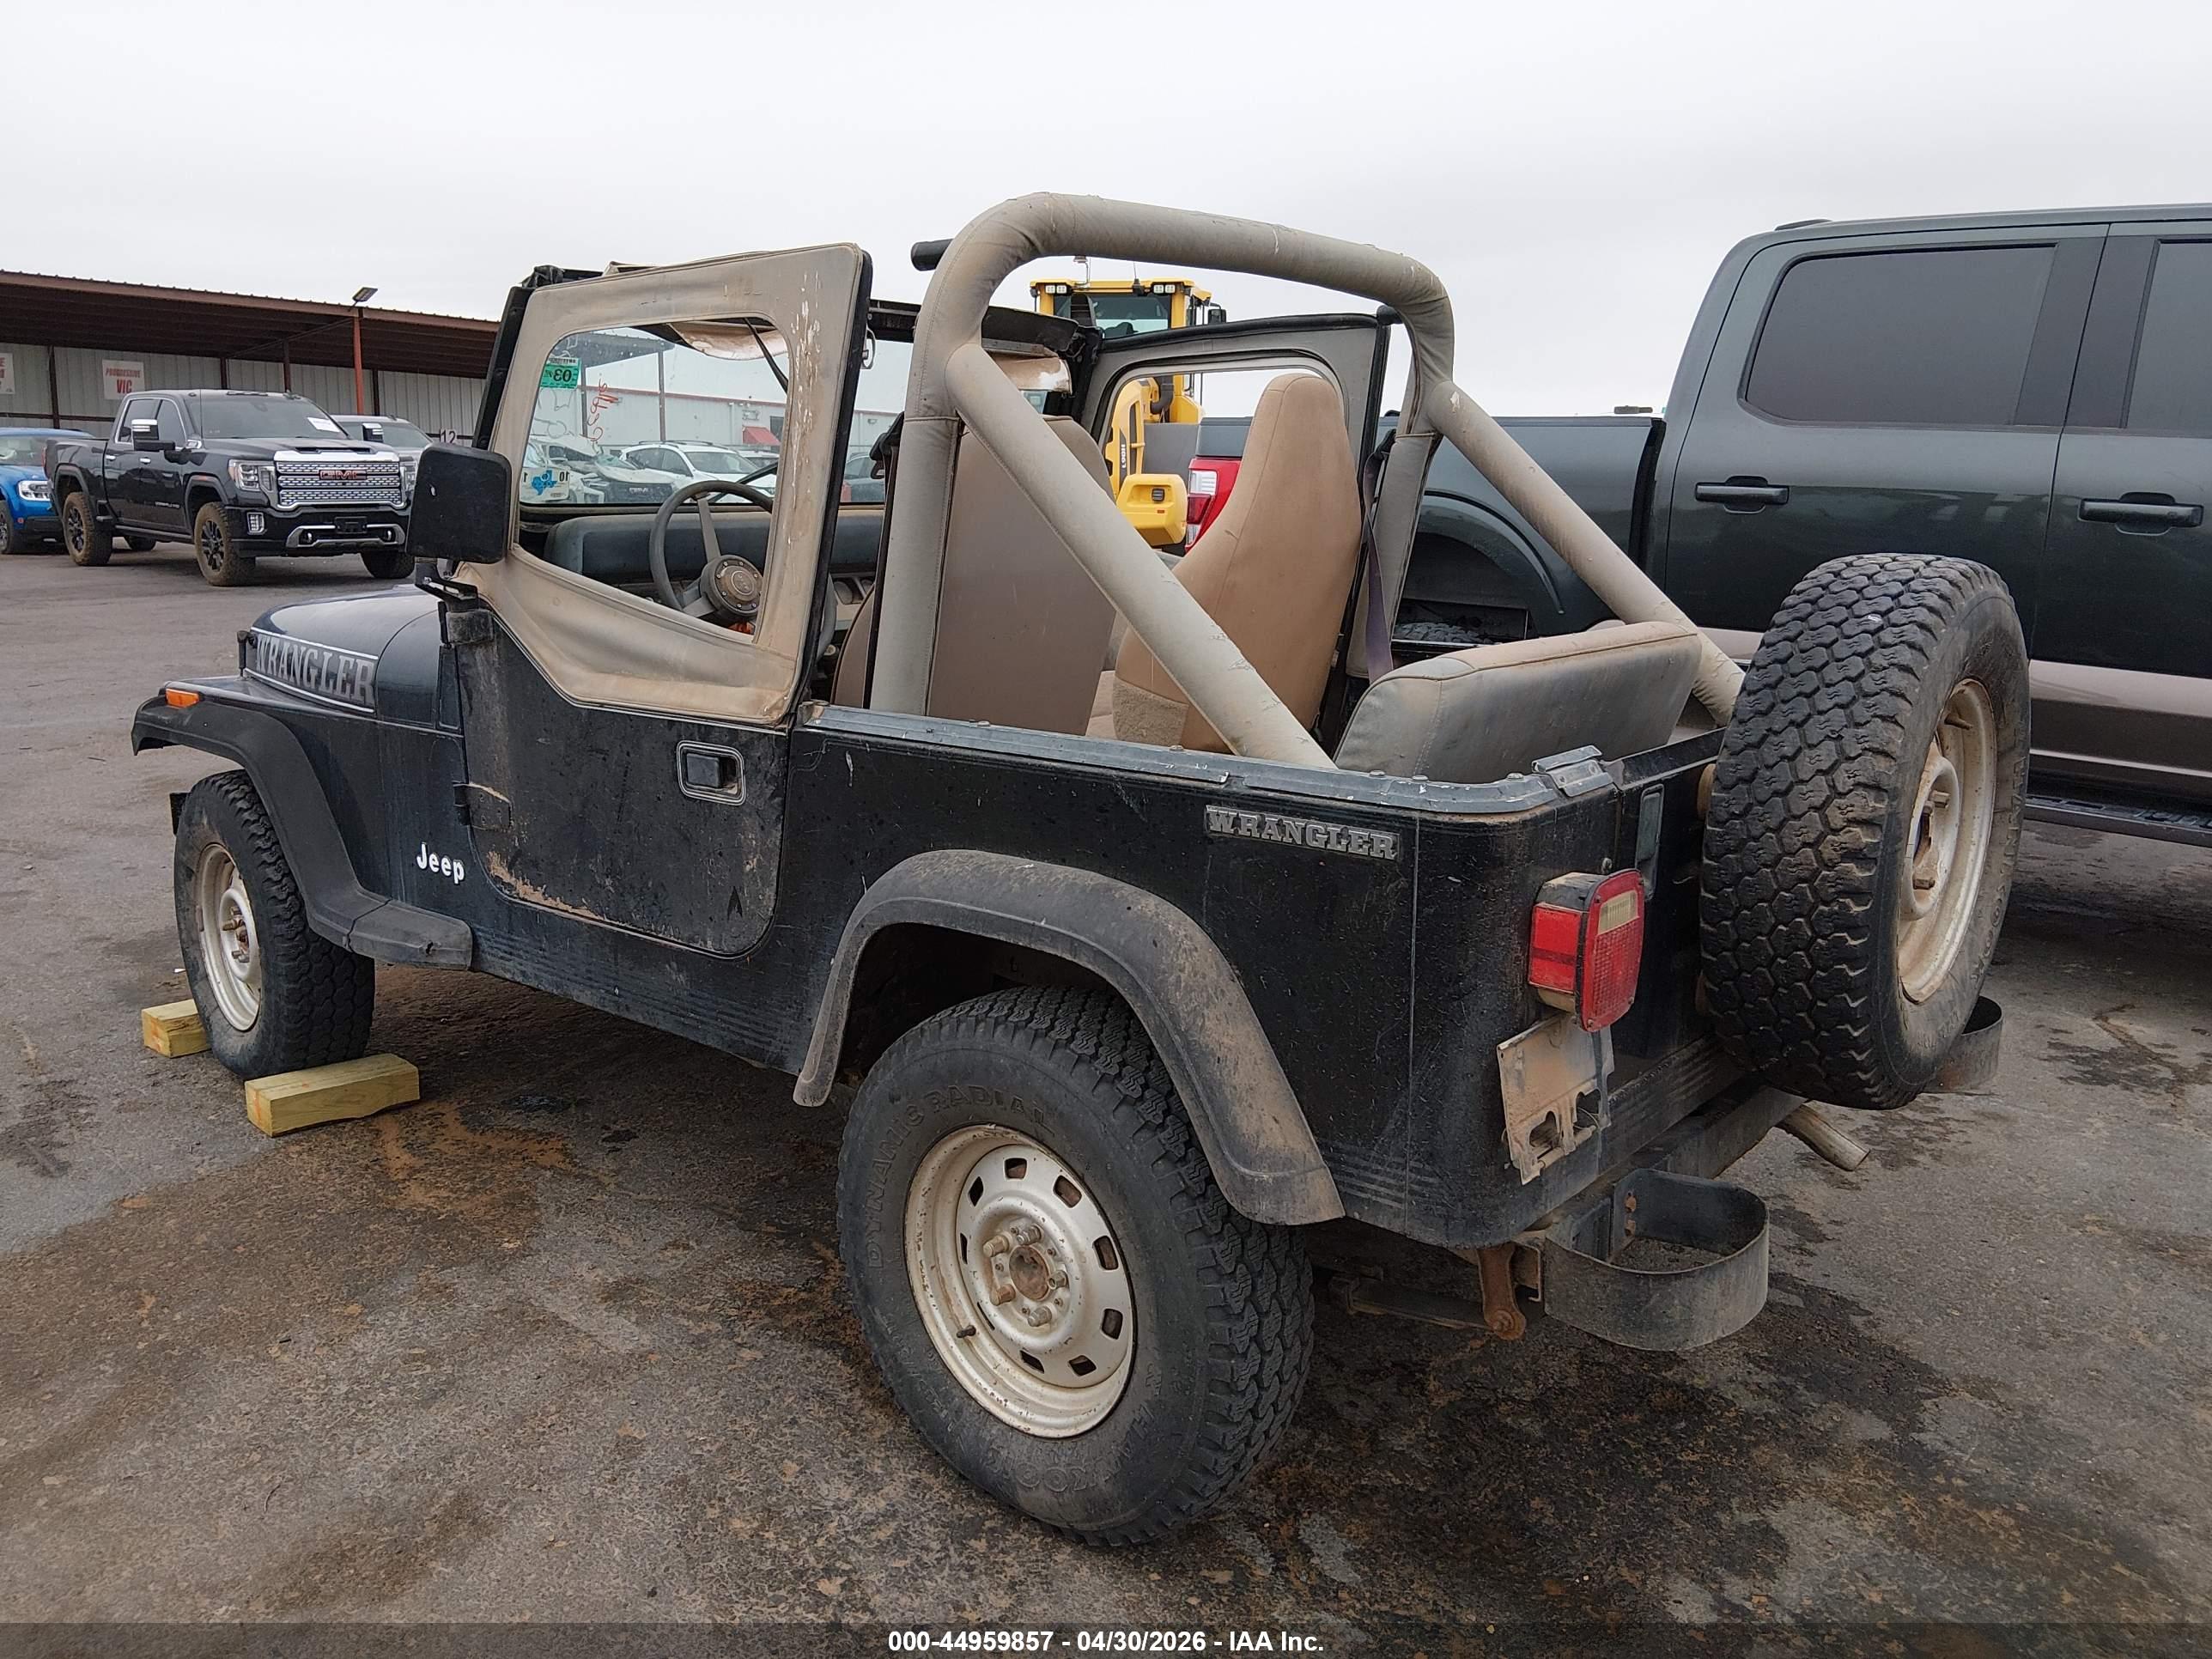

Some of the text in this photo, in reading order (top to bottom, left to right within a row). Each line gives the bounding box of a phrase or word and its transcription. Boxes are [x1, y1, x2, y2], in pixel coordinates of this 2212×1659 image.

[116, 379, 133, 393] VIC
[319, 470, 367, 480] GMC
[256, 633, 375, 706] WRANGLER
[1206, 806, 1399, 860] WRANGLER
[416, 841, 465, 884] Jeep
[864, 1085, 1055, 1269] DYNAMIC RADIAL
